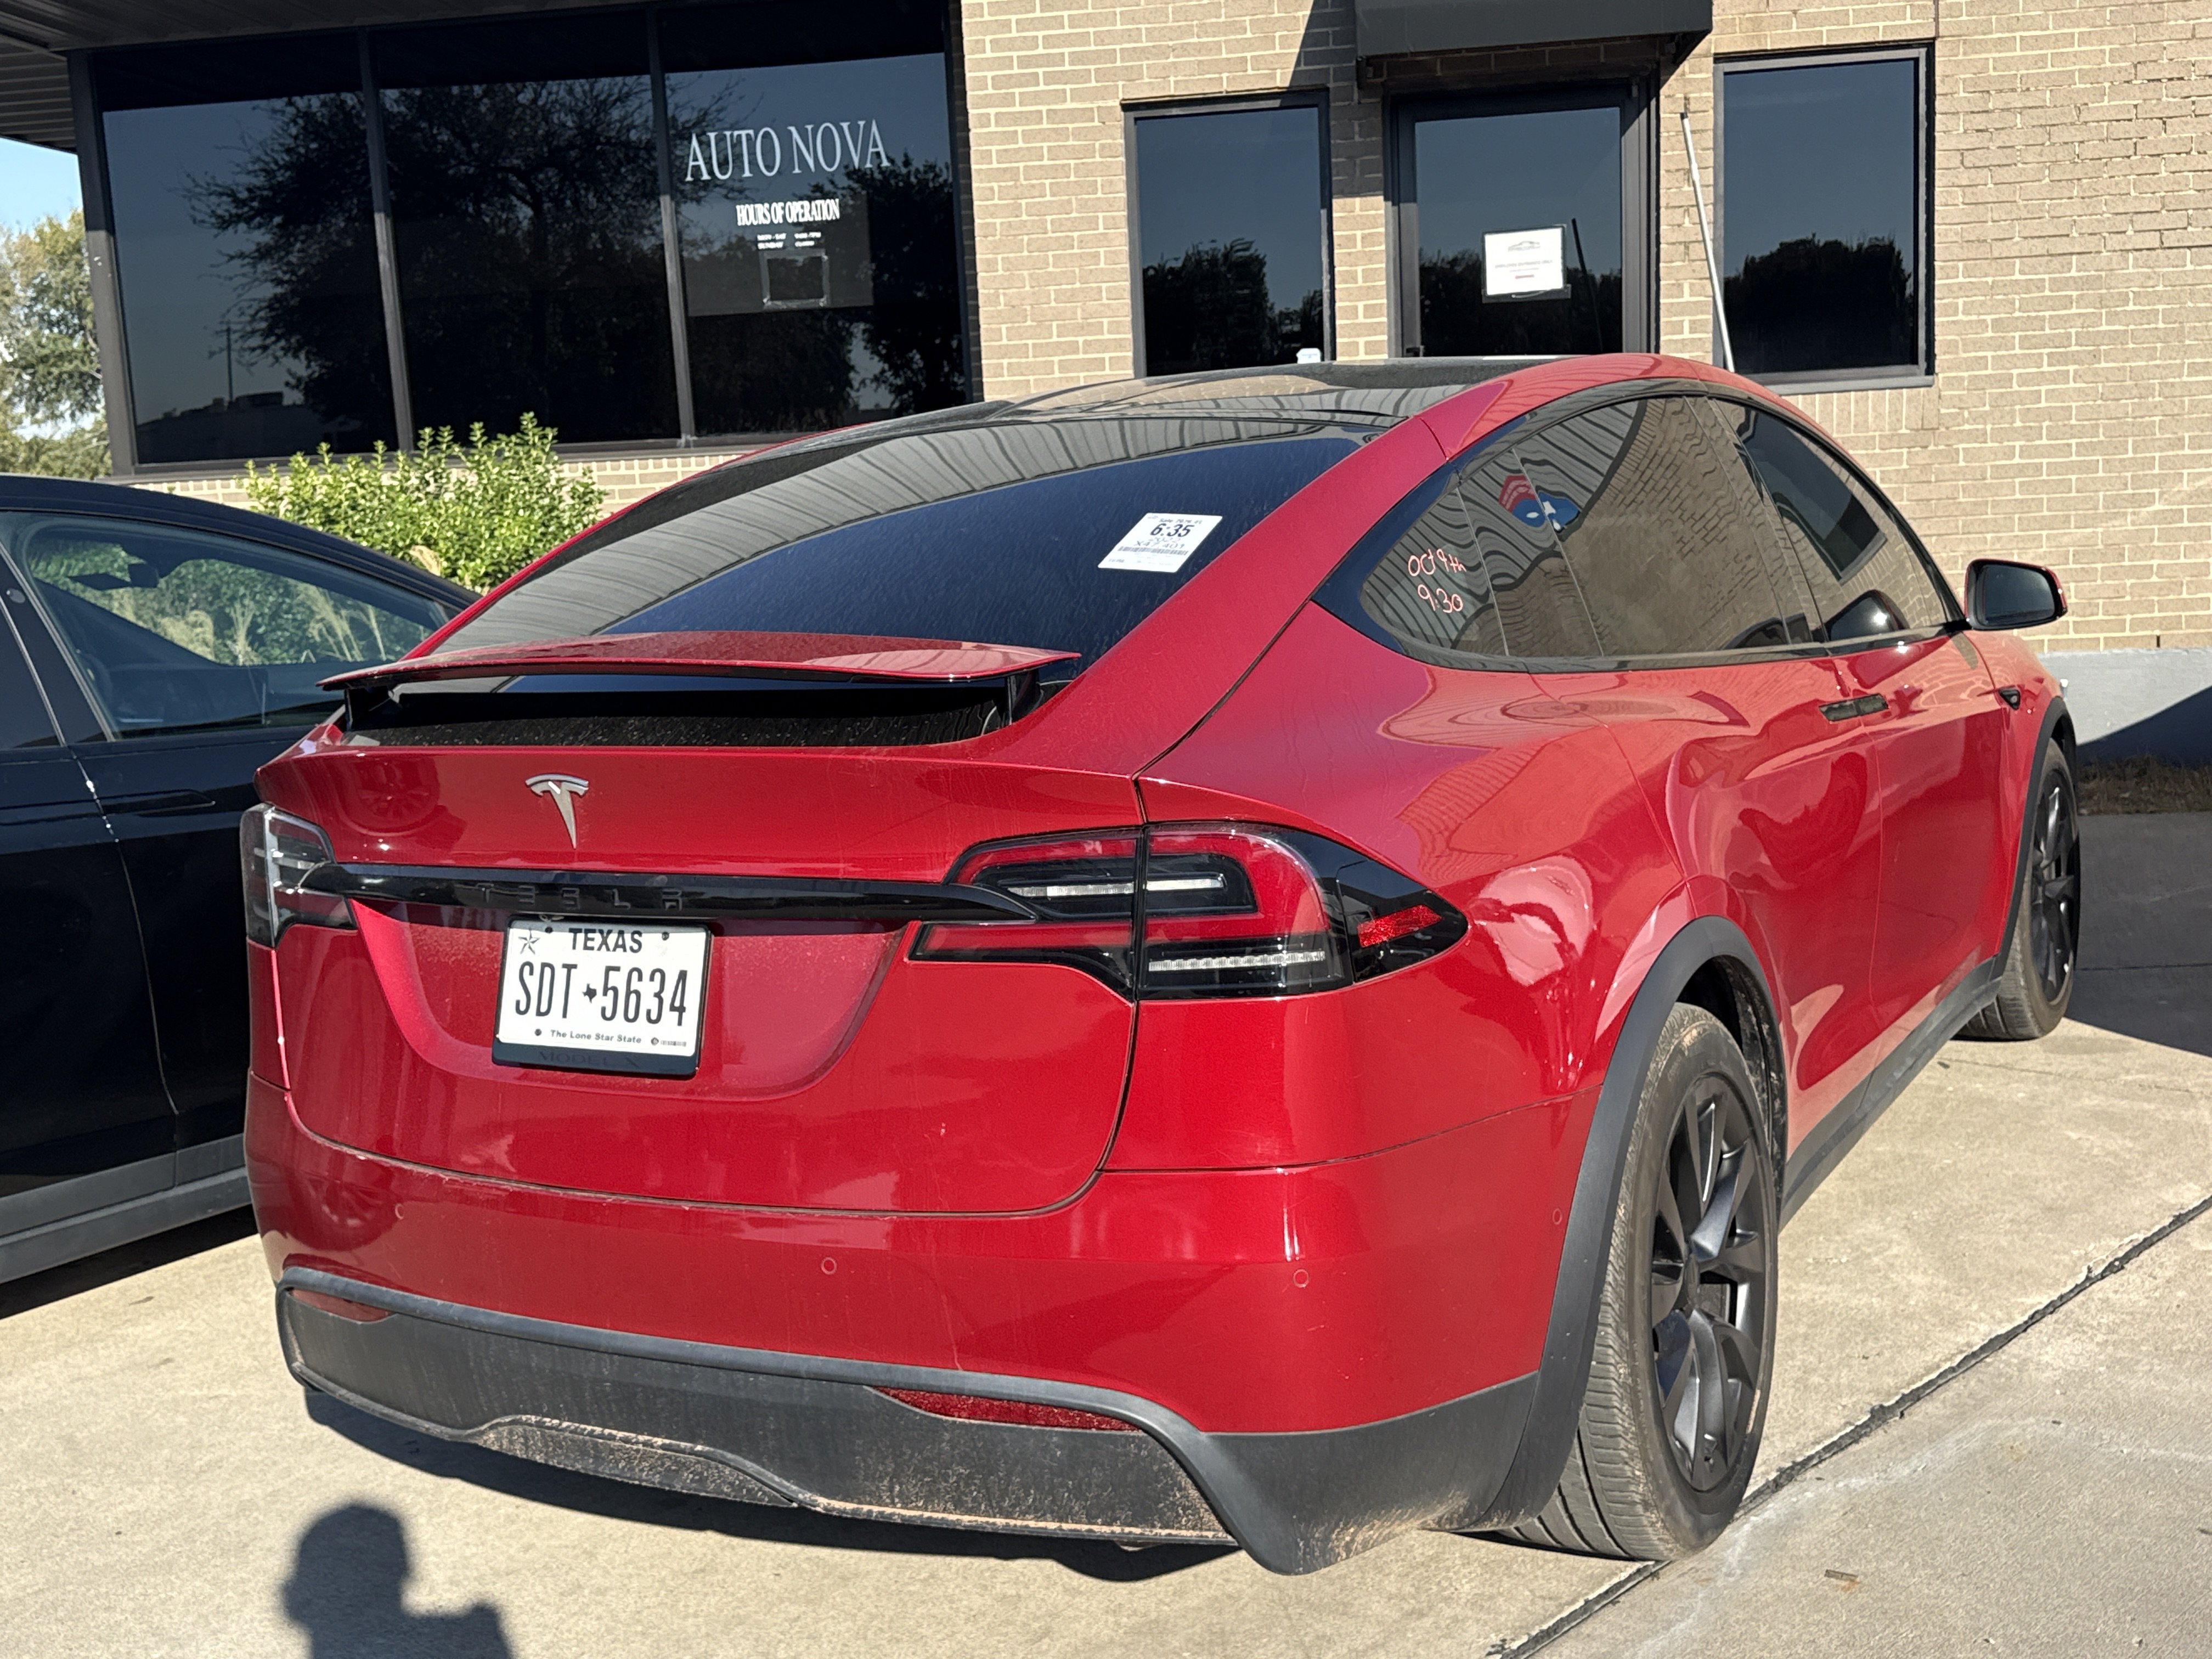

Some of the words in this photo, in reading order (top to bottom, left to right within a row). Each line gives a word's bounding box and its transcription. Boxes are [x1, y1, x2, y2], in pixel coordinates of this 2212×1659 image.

[685, 127, 781, 181] AUTO
[787, 119, 890, 174] NOVA
[736, 203, 771, 226] HOURS
[771, 202, 785, 224] OF
[785, 198, 840, 223] OPERATION
[1150, 523, 1194, 537] 6:35
[1418, 584, 1463, 613] 9:30
[569, 927, 643, 953] TEXAS
[551, 1029, 567, 1038] The
[570, 1031, 592, 1040] Lone
[595, 1032, 614, 1041] Star
[617, 1034, 642, 1043] State
